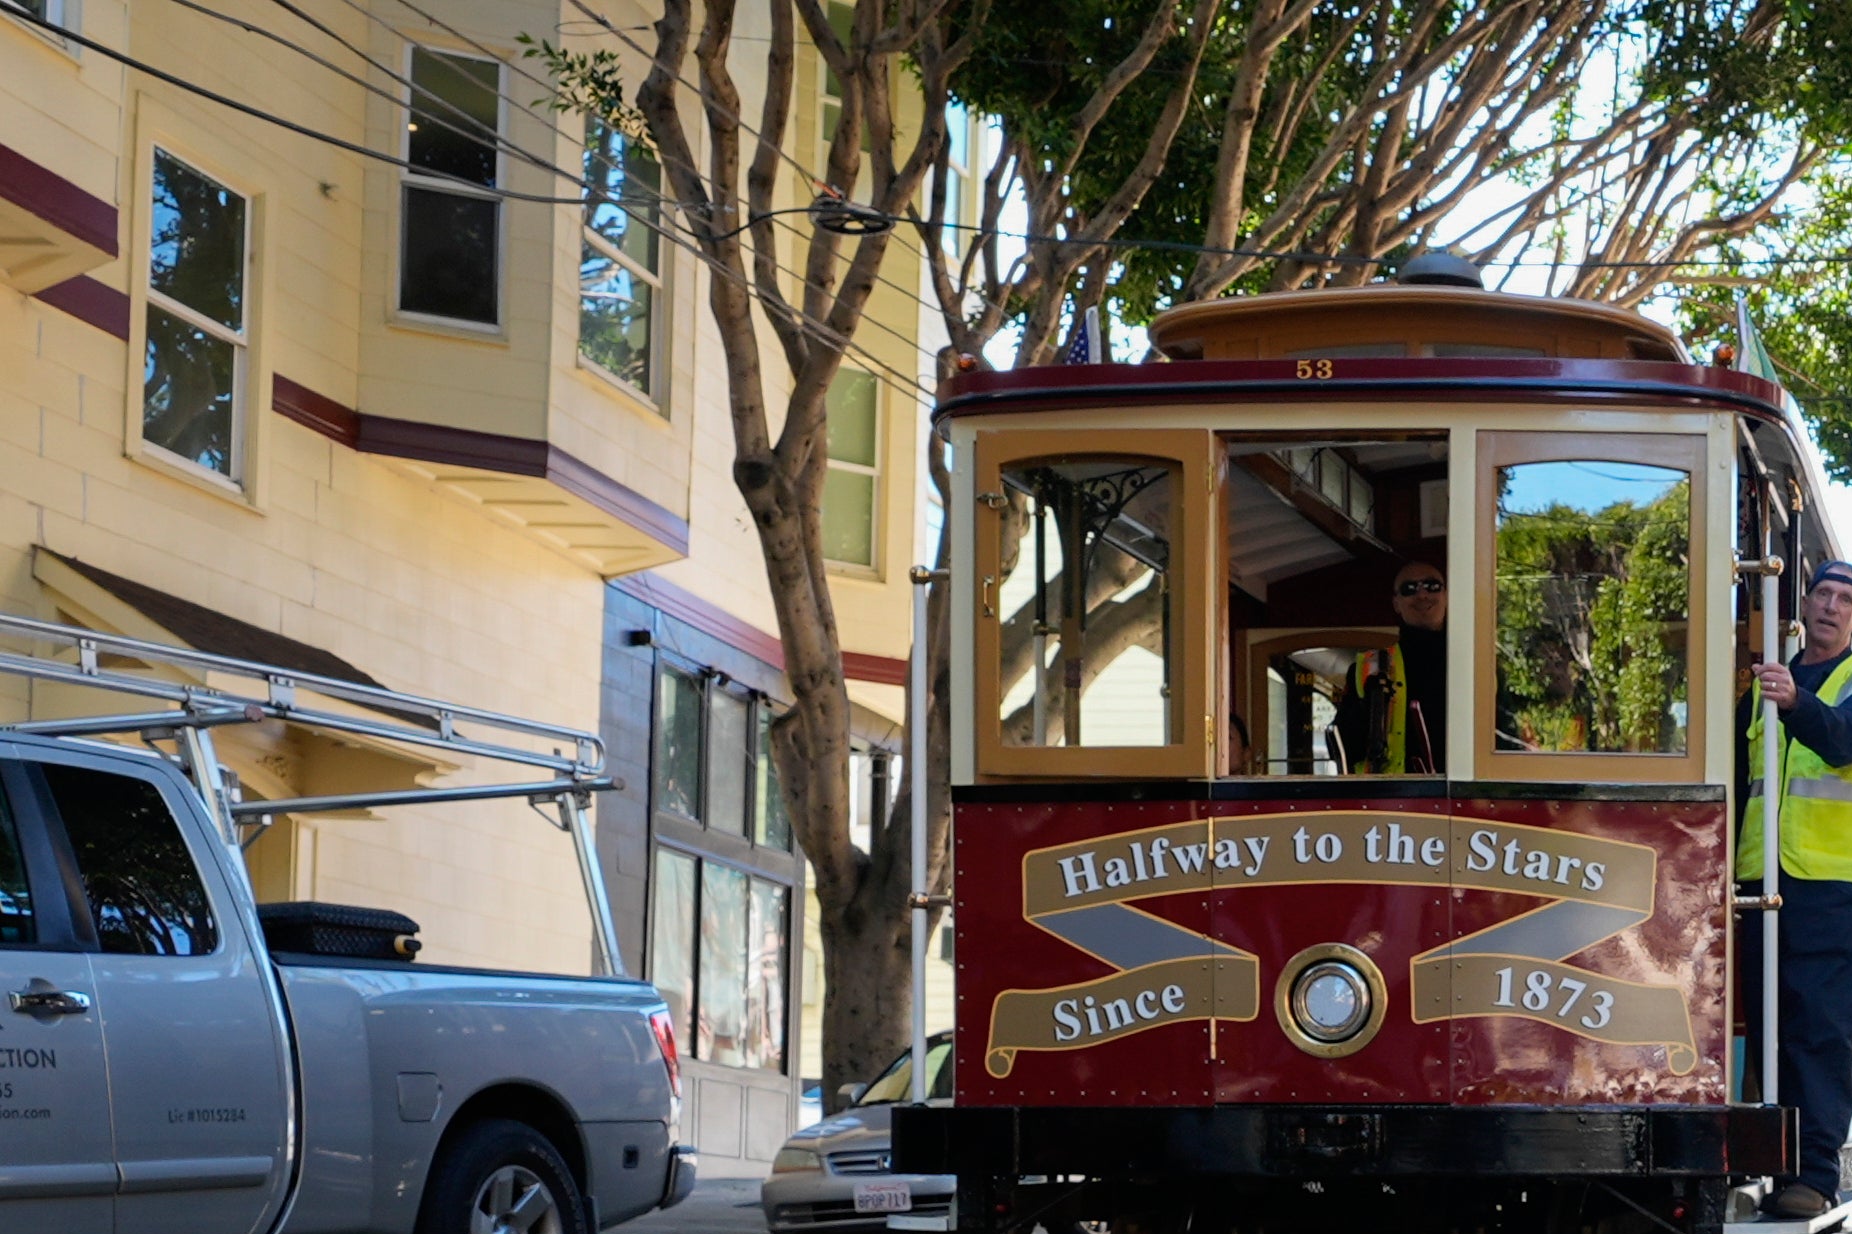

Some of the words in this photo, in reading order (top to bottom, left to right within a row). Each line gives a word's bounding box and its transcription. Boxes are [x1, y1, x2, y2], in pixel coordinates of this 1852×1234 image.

[1296, 359, 1333, 379] 53
[1057, 835, 1271, 897] Halfway
[1293, 825, 1342, 865] to
[1364, 823, 1446, 866] the
[1466, 829, 1607, 892] Stars
[1053, 983, 1185, 1043] Since
[1493, 966, 1615, 1030] 1873
